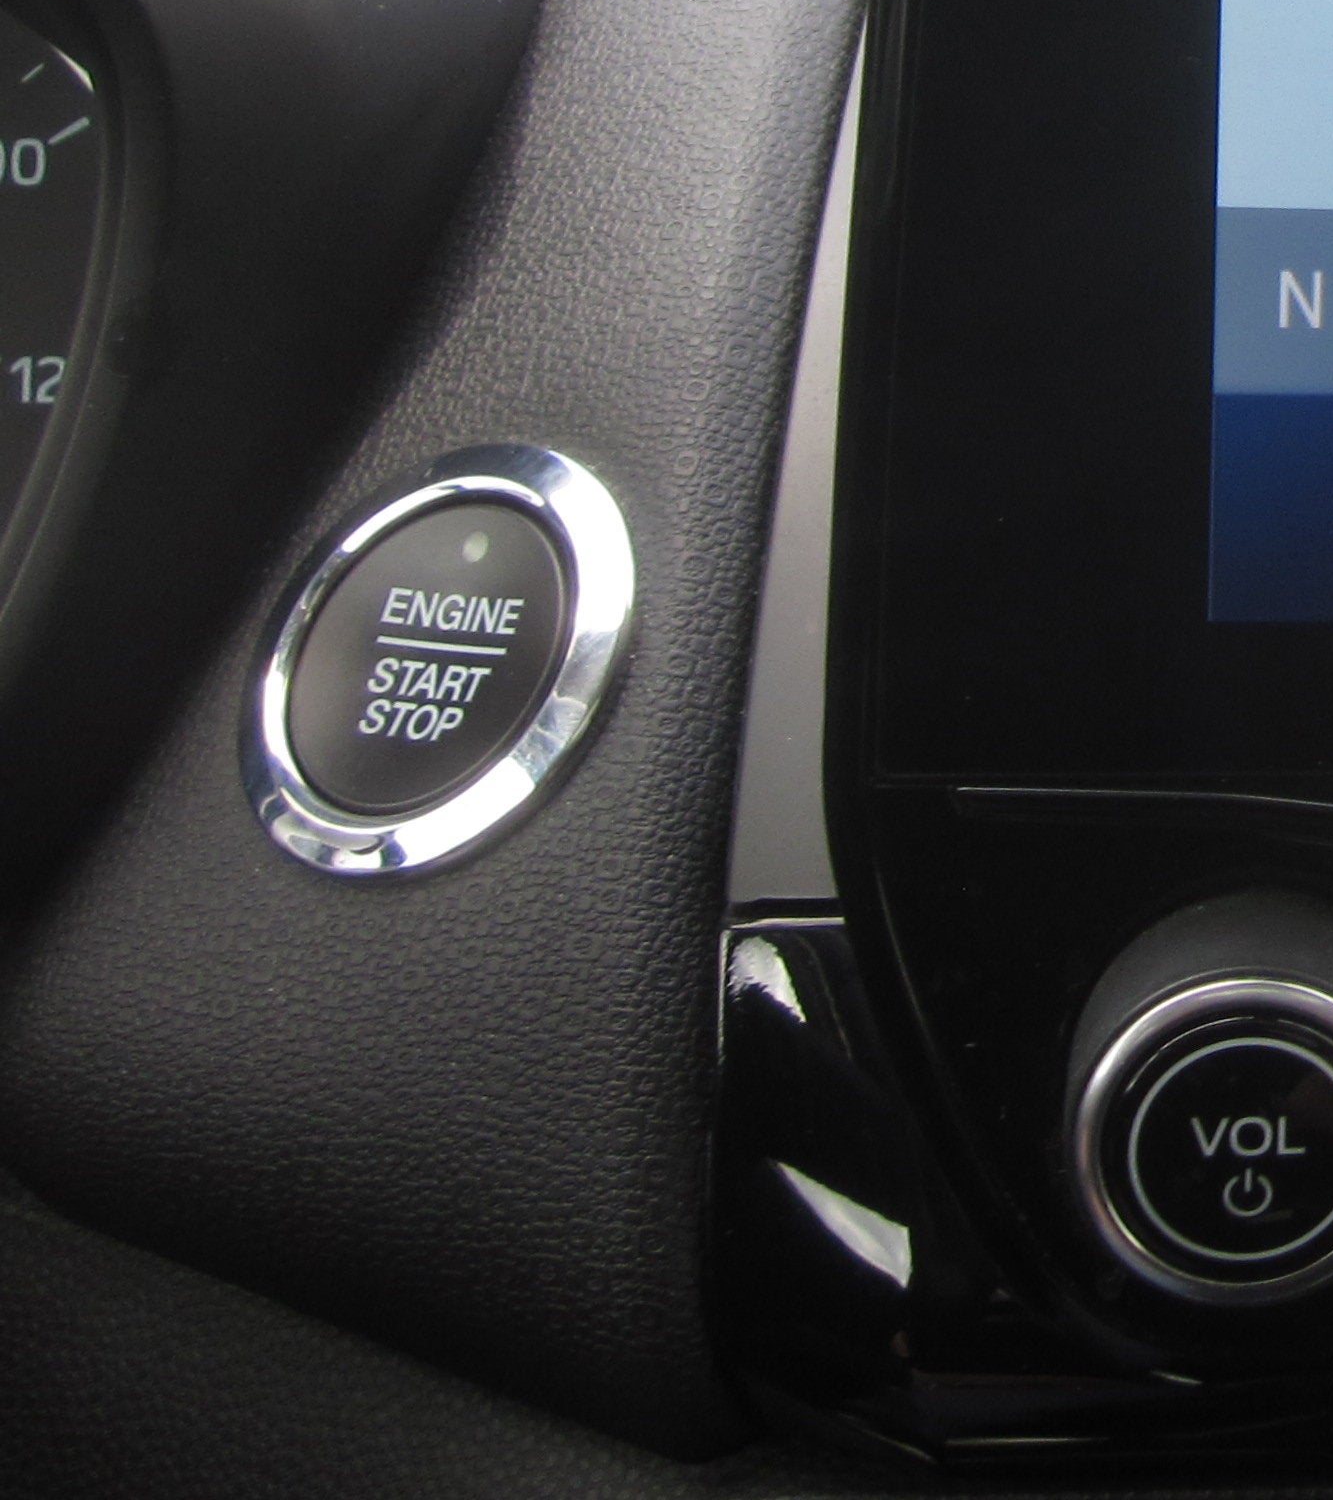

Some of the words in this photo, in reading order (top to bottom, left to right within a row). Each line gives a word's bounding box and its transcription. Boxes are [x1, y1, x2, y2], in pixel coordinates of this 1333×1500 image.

[1277, 268, 1324, 330] N
[380, 587, 526, 635] ENGINE
[367, 657, 493, 703] START
[358, 699, 464, 742] STOP
[1190, 1114, 1307, 1158] VOL
